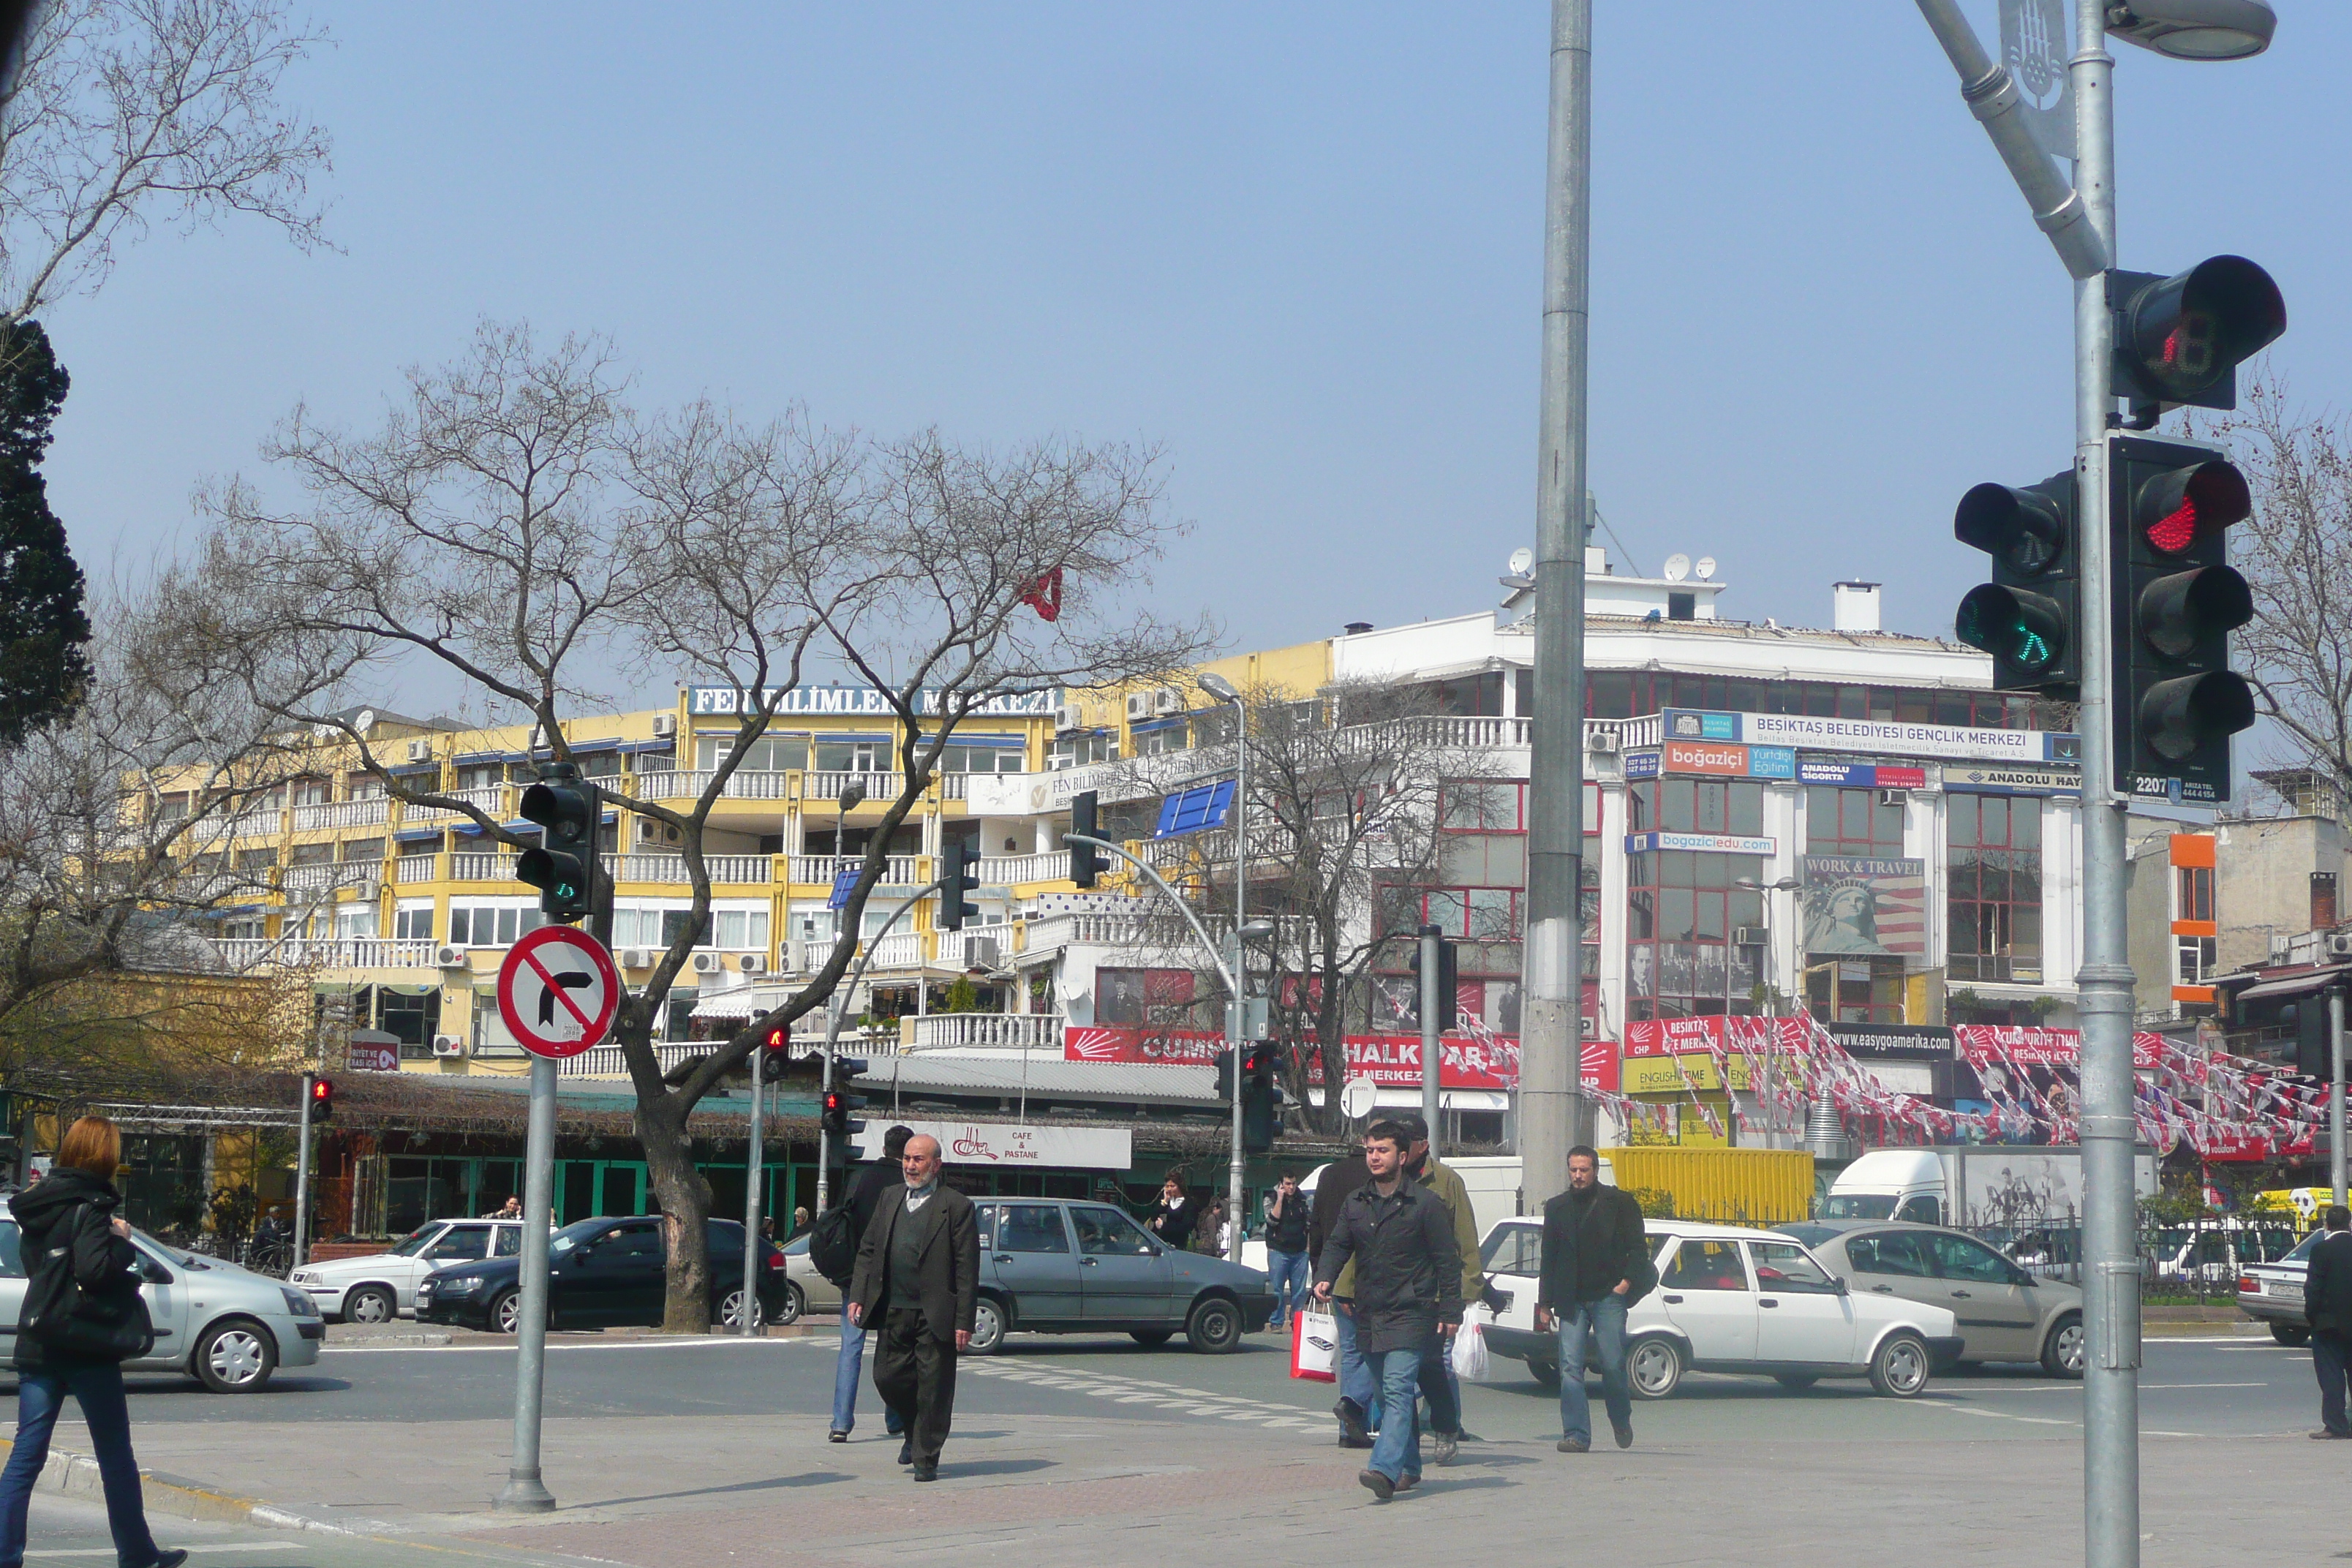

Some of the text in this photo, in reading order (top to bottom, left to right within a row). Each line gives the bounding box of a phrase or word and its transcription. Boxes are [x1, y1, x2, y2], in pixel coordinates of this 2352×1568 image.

[1757, 717, 2027, 747] BEŞİKTAŞ BELEDİYESİ GENÇLİK MERKEZİ
[1752, 748, 1791, 763] Yurtdışı
[1934, 745, 1962, 755] Sanayi
[1978, 747, 2008, 757] Ticaret
[1673, 747, 1742, 769] boğaziçi
[1754, 761, 1789, 774] Eğitim
[1801, 764, 1850, 774] ANADOLU
[1801, 772, 1844, 781] SİGORTA
[1988, 772, 2050, 785] ANADOLU
[1053, 777, 1071, 794] FEN
[2136, 776, 2167, 793] 2207
[2182, 788, 2196, 797] 444
[2203, 790, 2215, 799] 154
[1663, 834, 1771, 851] bogaziciedu.com
[1806, 859, 1923, 875] WORK & TRAVEL
[1833, 1032, 1951, 1052] www.easygoamerika.com
[1342, 1043, 1420, 1065] HALK
[1634, 1046, 1649, 1055] CHP
[1362, 1070, 1422, 1082] MERKEZ
[1640, 1071, 1676, 1083] ENGLISH
[1011, 1132, 1033, 1140] CAFE
[1018, 1141, 1025, 1150] &
[1004, 1150, 1039, 1159] PASTANE
